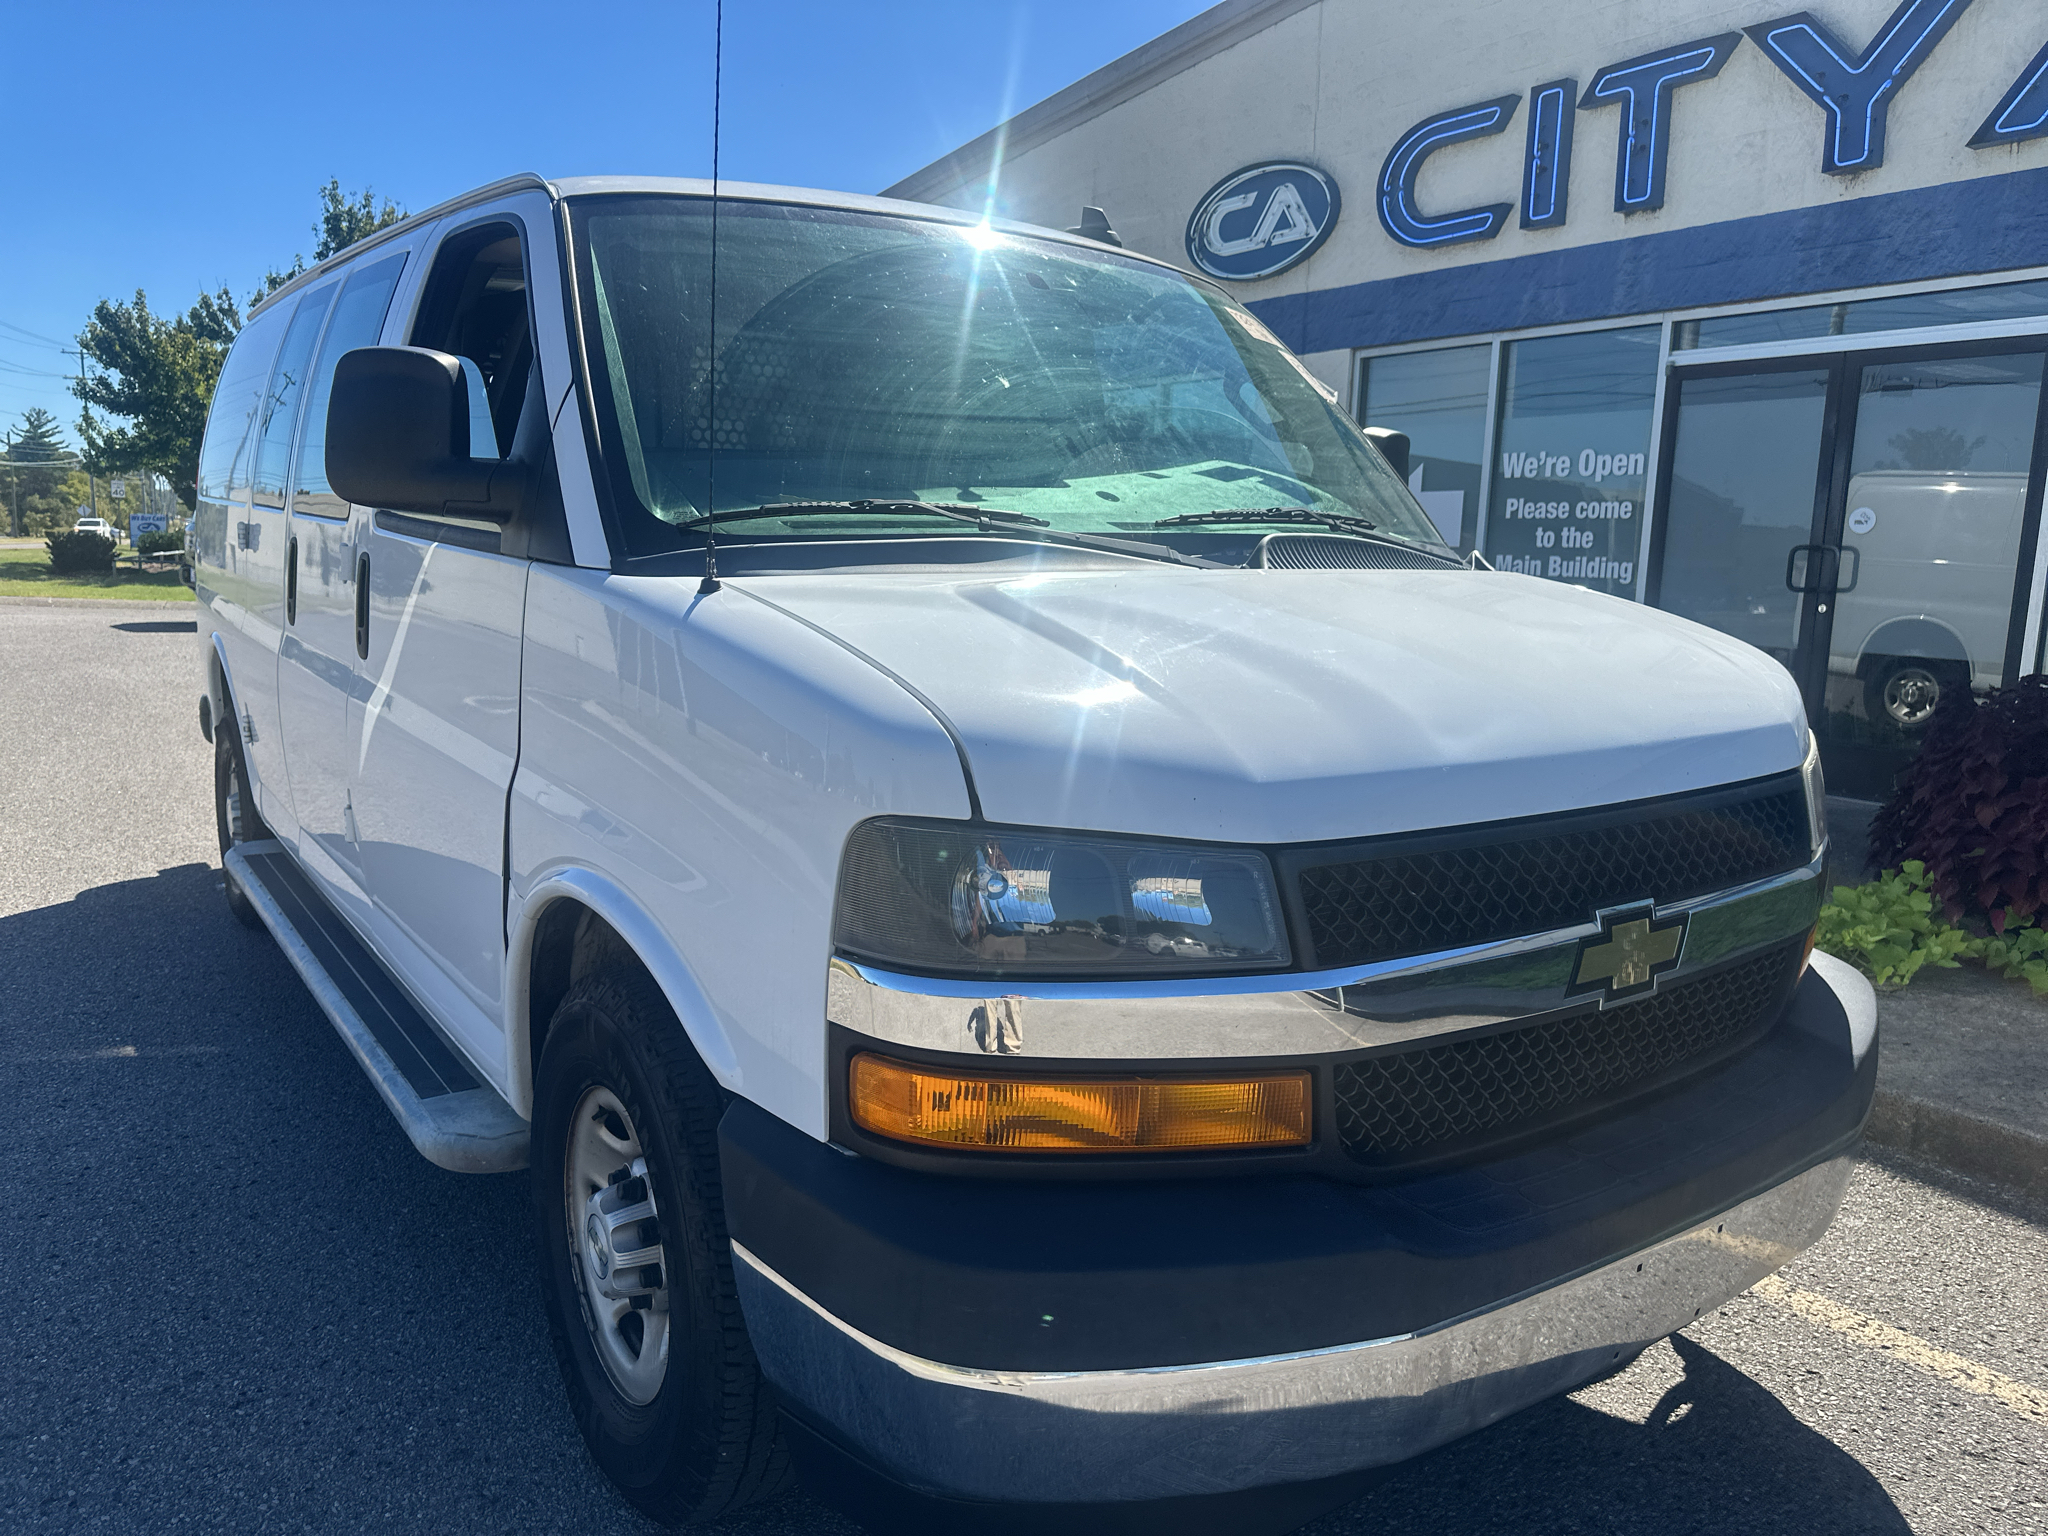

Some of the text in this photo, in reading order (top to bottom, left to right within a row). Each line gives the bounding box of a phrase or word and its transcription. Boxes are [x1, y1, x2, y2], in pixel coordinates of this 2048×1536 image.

[1376, 0, 1974, 250] CITY
[1502, 448, 1645, 482] We're Open
[1505, 498, 1633, 519] Please come
[1535, 526, 1594, 549] to the
[1495, 554, 1633, 585] Main Building
